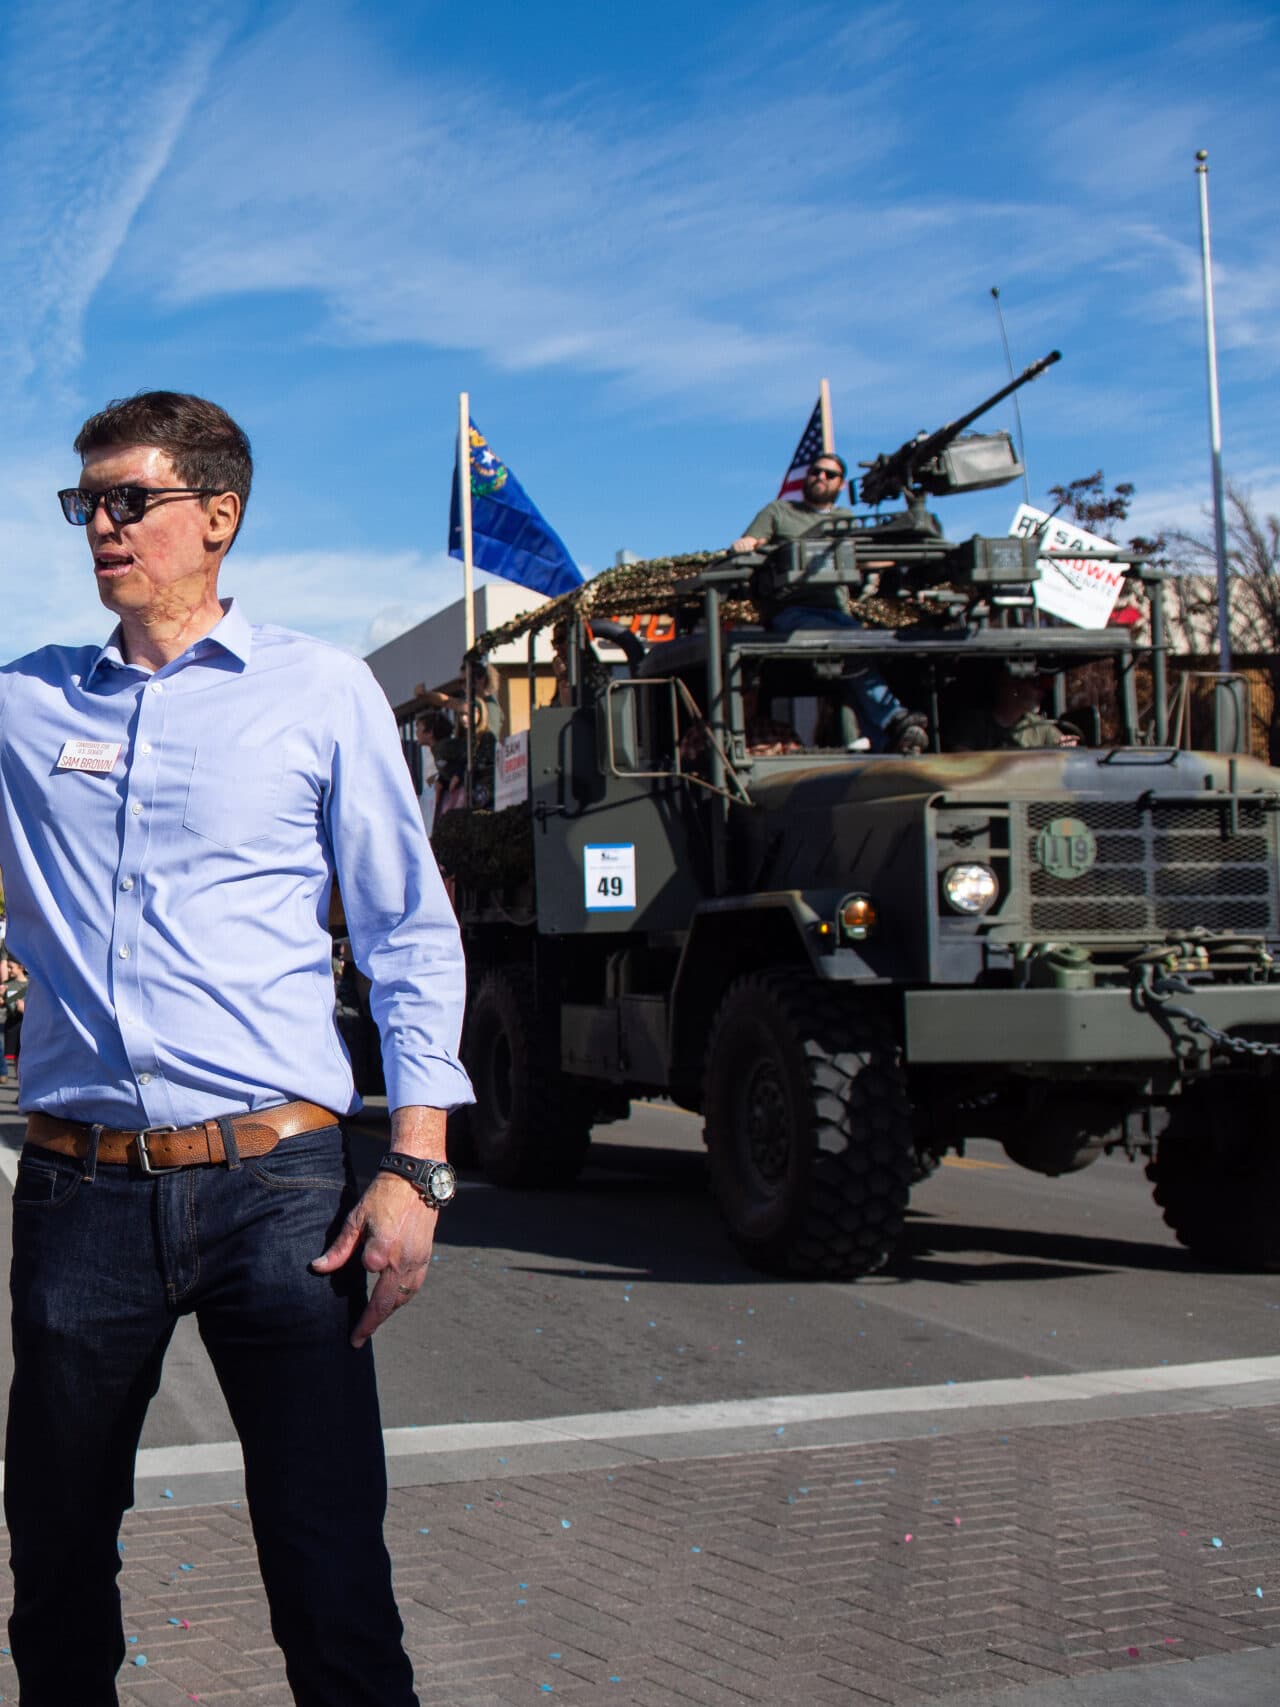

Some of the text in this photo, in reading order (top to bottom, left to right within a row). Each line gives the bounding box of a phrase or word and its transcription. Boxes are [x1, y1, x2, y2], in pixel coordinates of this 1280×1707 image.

[61, 756, 112, 769] SAM BROWN
[597, 876, 623, 896] 49
